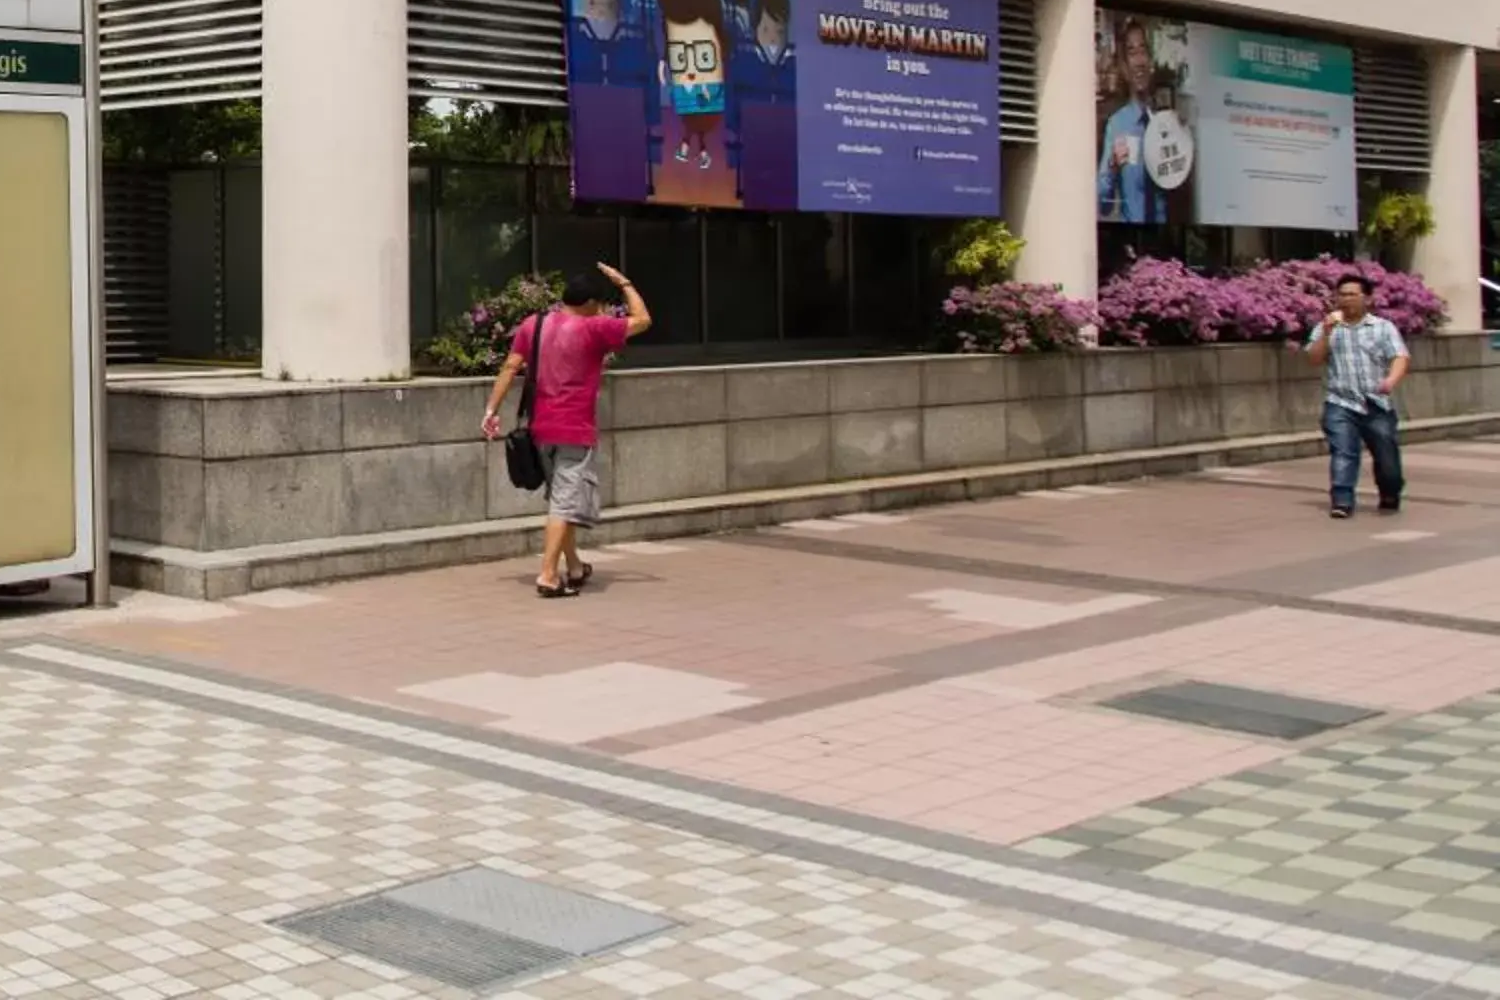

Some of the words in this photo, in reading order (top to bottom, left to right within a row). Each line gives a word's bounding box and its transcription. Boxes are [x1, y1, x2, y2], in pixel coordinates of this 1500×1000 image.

[903, 2, 925, 17] out
[927, 3, 949, 20] the
[819, 13, 905, 47] MOVE-IN
[908, 25, 987, 57] MARTIN
[886, 55, 900, 71] in
[903, 60, 930, 75] you.
